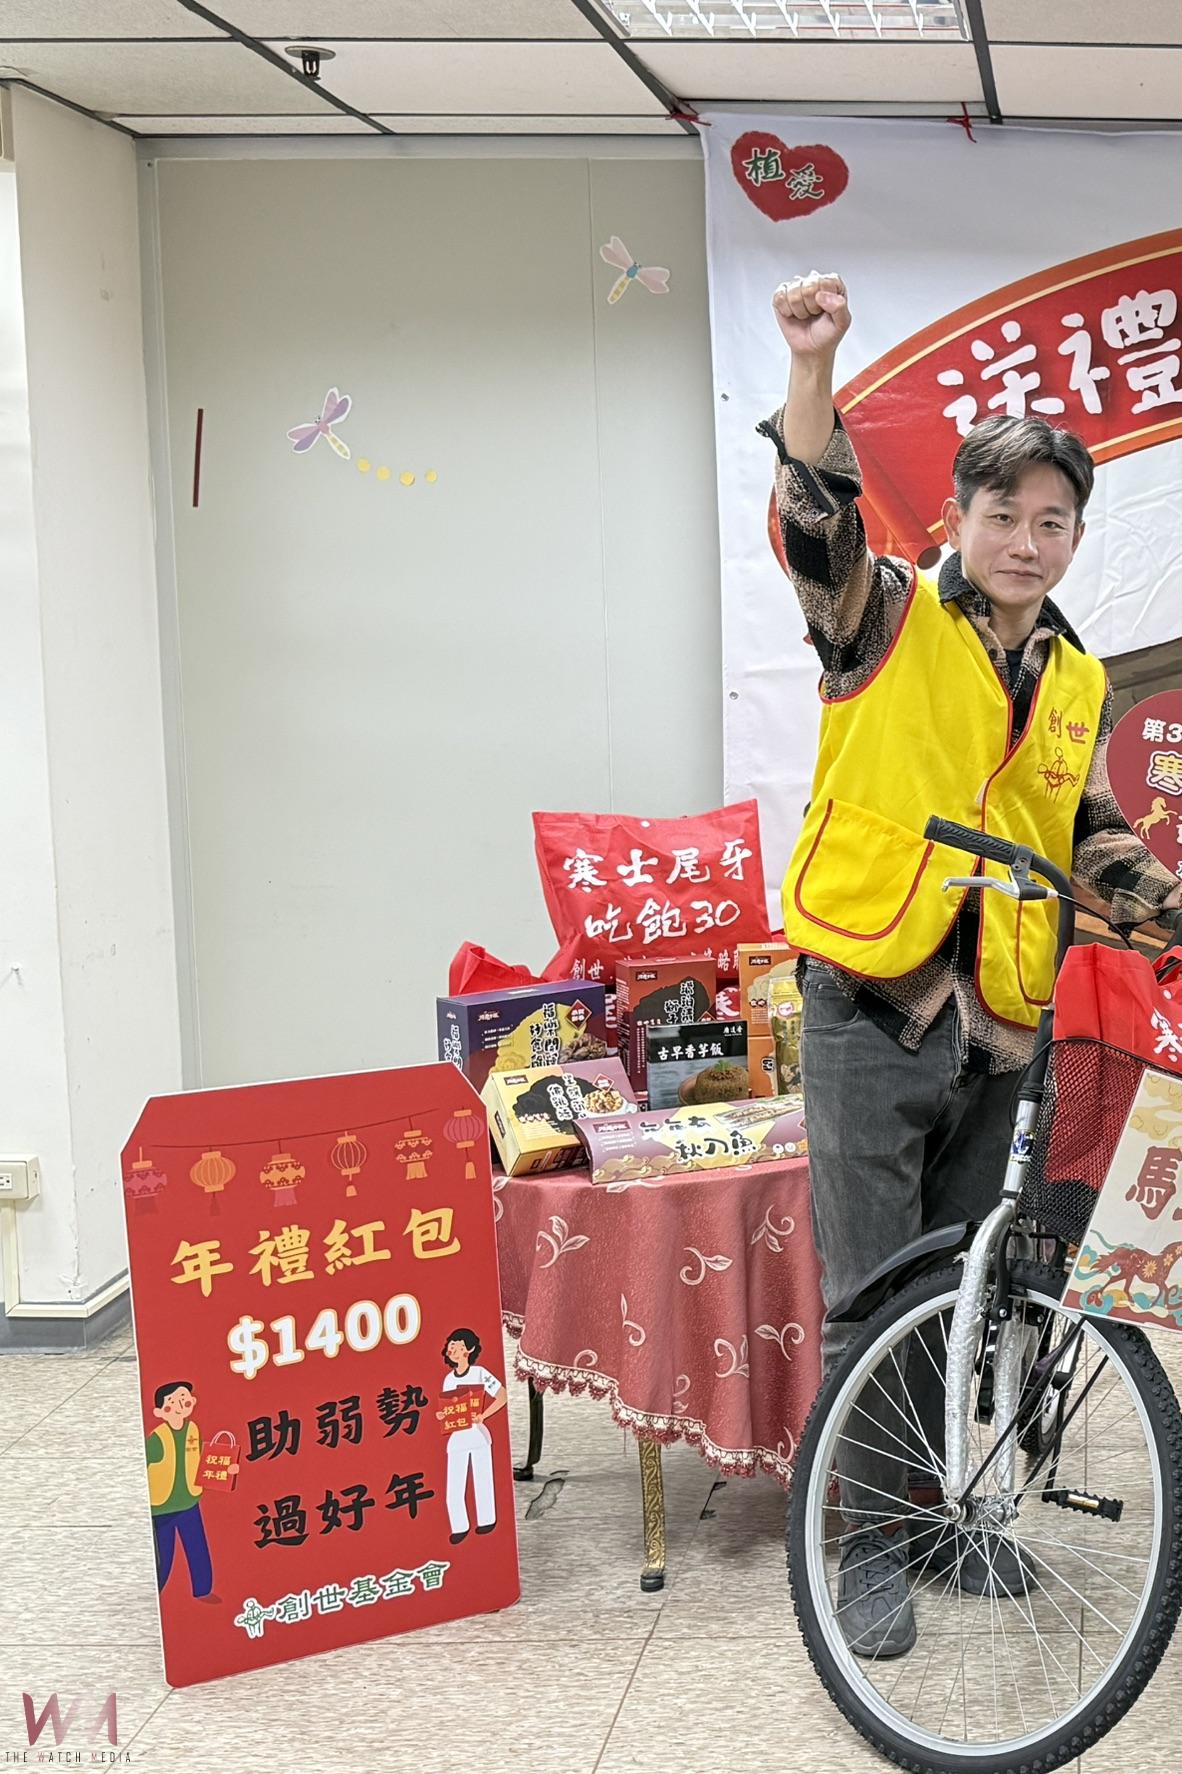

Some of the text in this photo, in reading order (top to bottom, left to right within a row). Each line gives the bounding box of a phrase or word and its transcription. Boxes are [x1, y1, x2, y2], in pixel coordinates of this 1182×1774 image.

[742, 148, 825, 200] 植愛
[1048, 706, 1090, 745] 創世
[562, 839, 753, 893] 寒士尾牙
[585, 898, 741, 945] 吃飽30
[657, 1043, 724, 1061] 古早香芋飯
[170, 1207, 462, 1297] 年禮紅包
[226, 1293, 422, 1379] $1400
[245, 1384, 428, 1462] 助弱勢
[206, 1454, 232, 1466] 祝福
[254, 1471, 435, 1549] 過好年
[275, 1560, 451, 1622] 創世基金會
